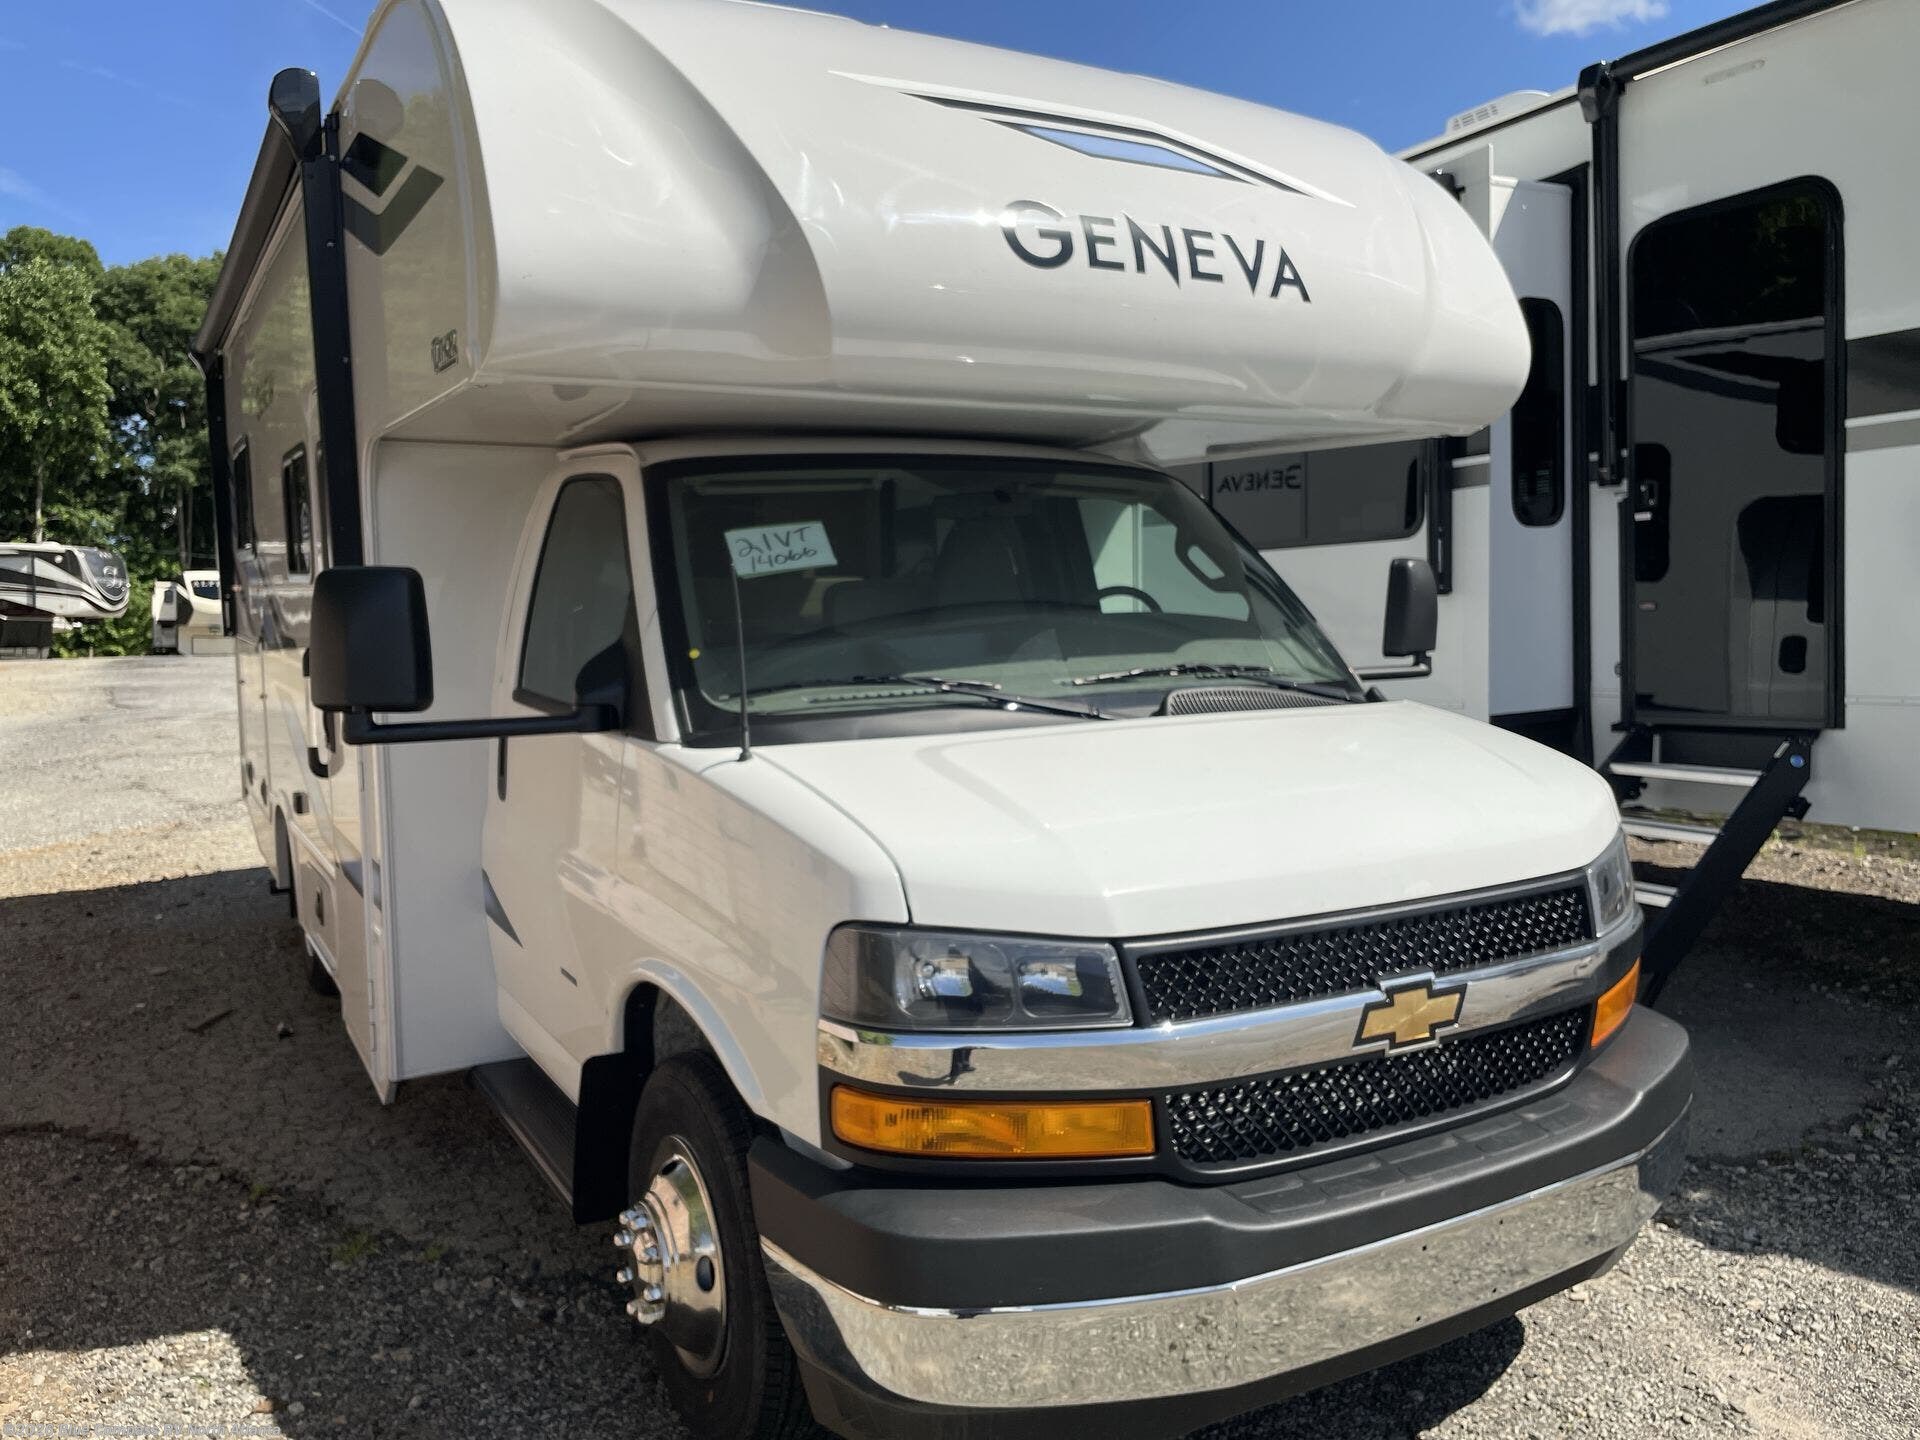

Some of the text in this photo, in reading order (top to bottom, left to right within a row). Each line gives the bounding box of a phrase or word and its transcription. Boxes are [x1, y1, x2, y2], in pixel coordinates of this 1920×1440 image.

[1001, 199, 1312, 304] GENEVA
[735, 526, 811, 558] 21VT
[751, 547, 817, 573] 14066
